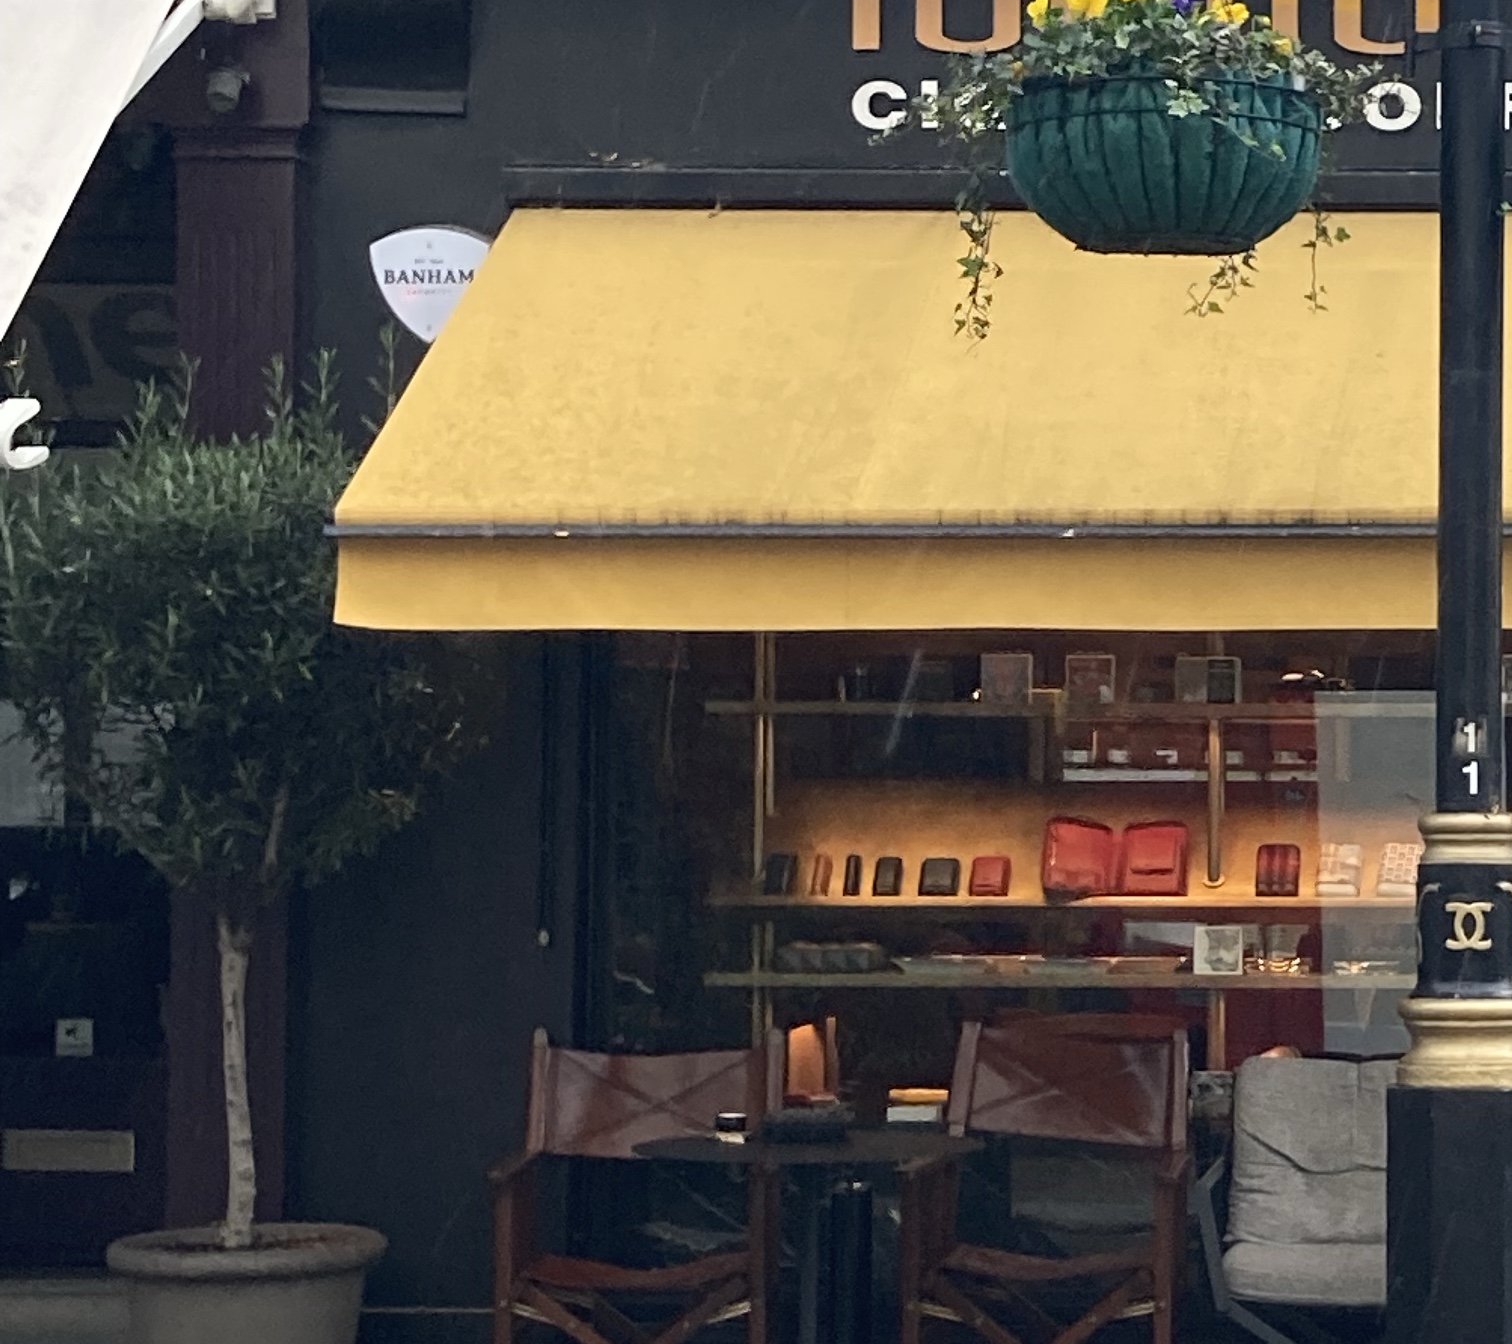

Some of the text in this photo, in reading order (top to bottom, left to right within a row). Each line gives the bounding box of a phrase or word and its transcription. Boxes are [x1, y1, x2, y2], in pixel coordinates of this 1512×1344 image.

[383, 268, 476, 285] BANHAM
[1463, 722, 1476, 753] 1
[1461, 760, 1479, 795] 1
